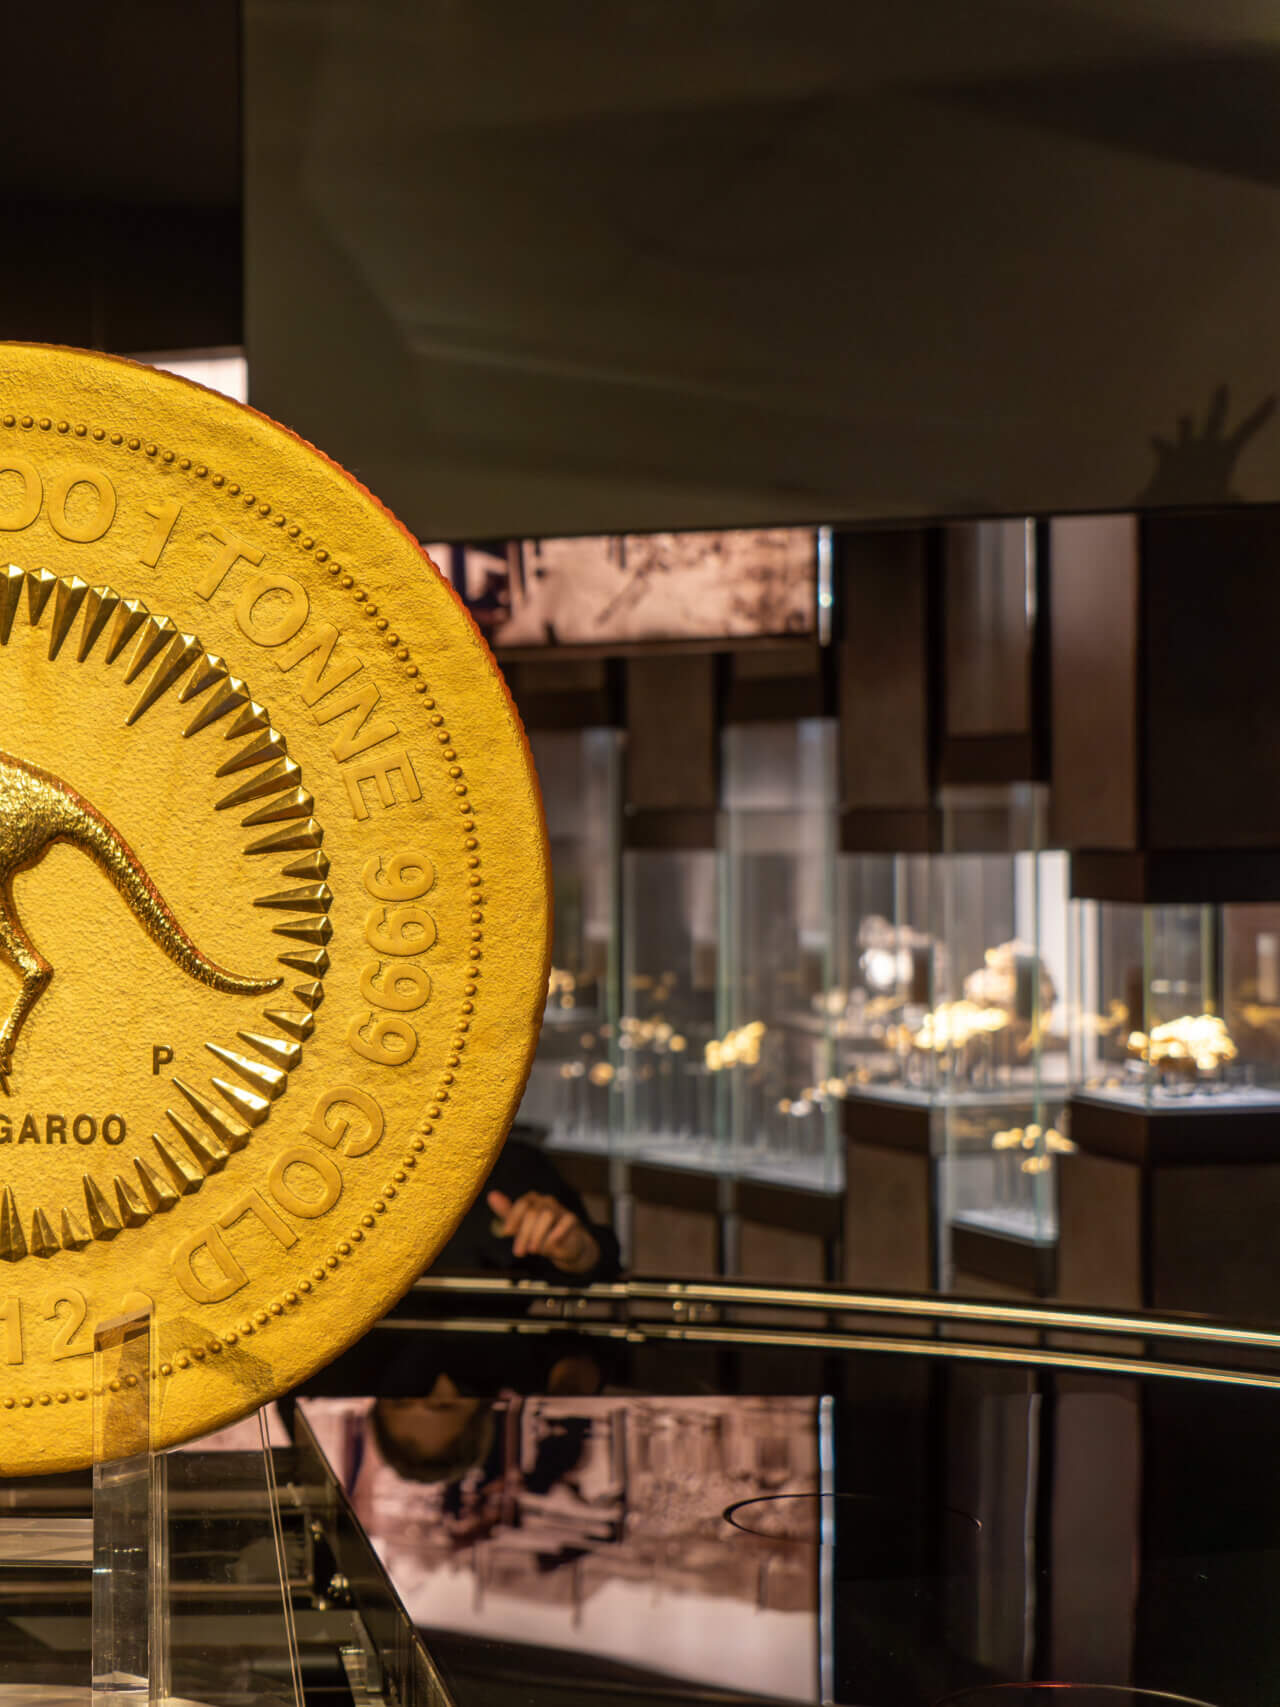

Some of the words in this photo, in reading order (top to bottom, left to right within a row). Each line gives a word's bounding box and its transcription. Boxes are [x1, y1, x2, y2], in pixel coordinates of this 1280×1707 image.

[139, 503, 182, 568] 1
[195, 531, 422, 822] TONNE
[152, 1044, 174, 1075] P
[348, 851, 437, 1066] 9999
[171, 1085, 385, 1304] GOLD
